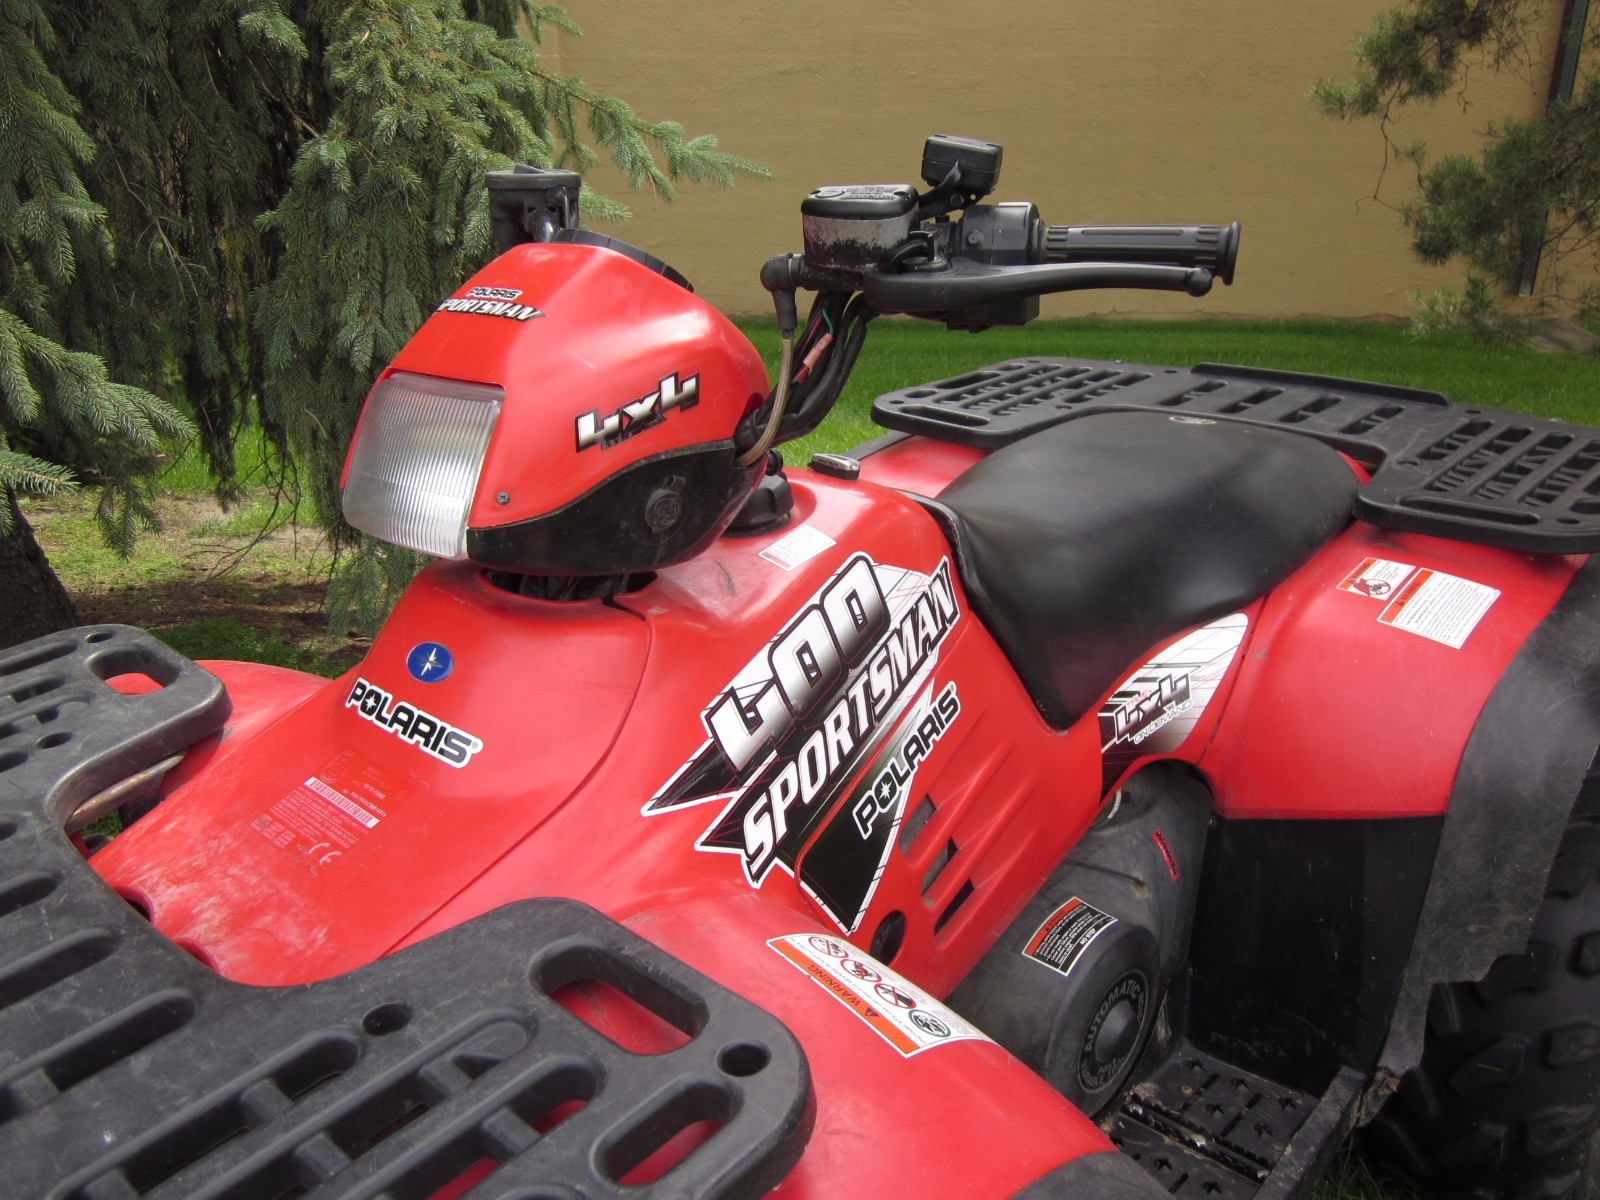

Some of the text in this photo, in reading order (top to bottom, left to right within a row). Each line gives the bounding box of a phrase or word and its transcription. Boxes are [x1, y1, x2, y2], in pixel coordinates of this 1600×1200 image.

[435, 298, 543, 322] PORTSMAN
[467, 287, 522, 300] POLARIS
[347, 680, 473, 764] POLARIS
[743, 563, 959, 877] SPORTSMAN
[854, 688, 960, 837] POLARIS
[807, 964, 863, 1007] WARNING
[1084, 979, 1140, 1051] AUTOMATIC
